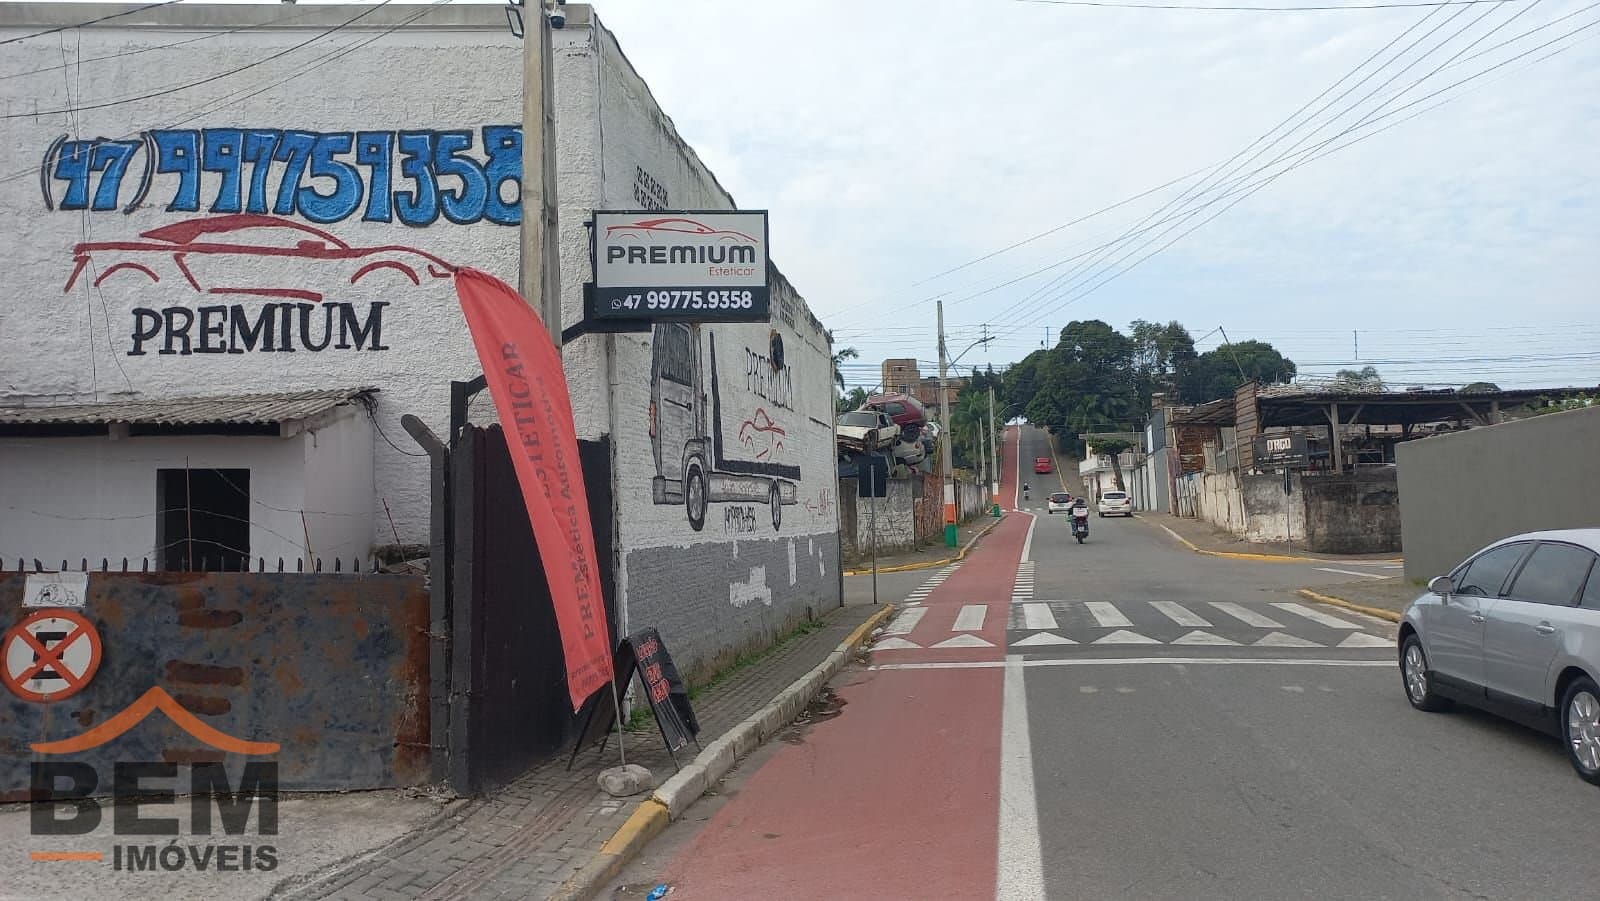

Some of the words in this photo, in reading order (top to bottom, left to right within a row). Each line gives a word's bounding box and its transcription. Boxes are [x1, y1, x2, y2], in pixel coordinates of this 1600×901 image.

[605, 245, 757, 264] PREMIUM
[708, 266, 755, 277] Esteticar
[623, 295, 642, 309] 47
[646, 291, 753, 310] 99775.9358
[126, 302, 391, 356] PREMIUM
